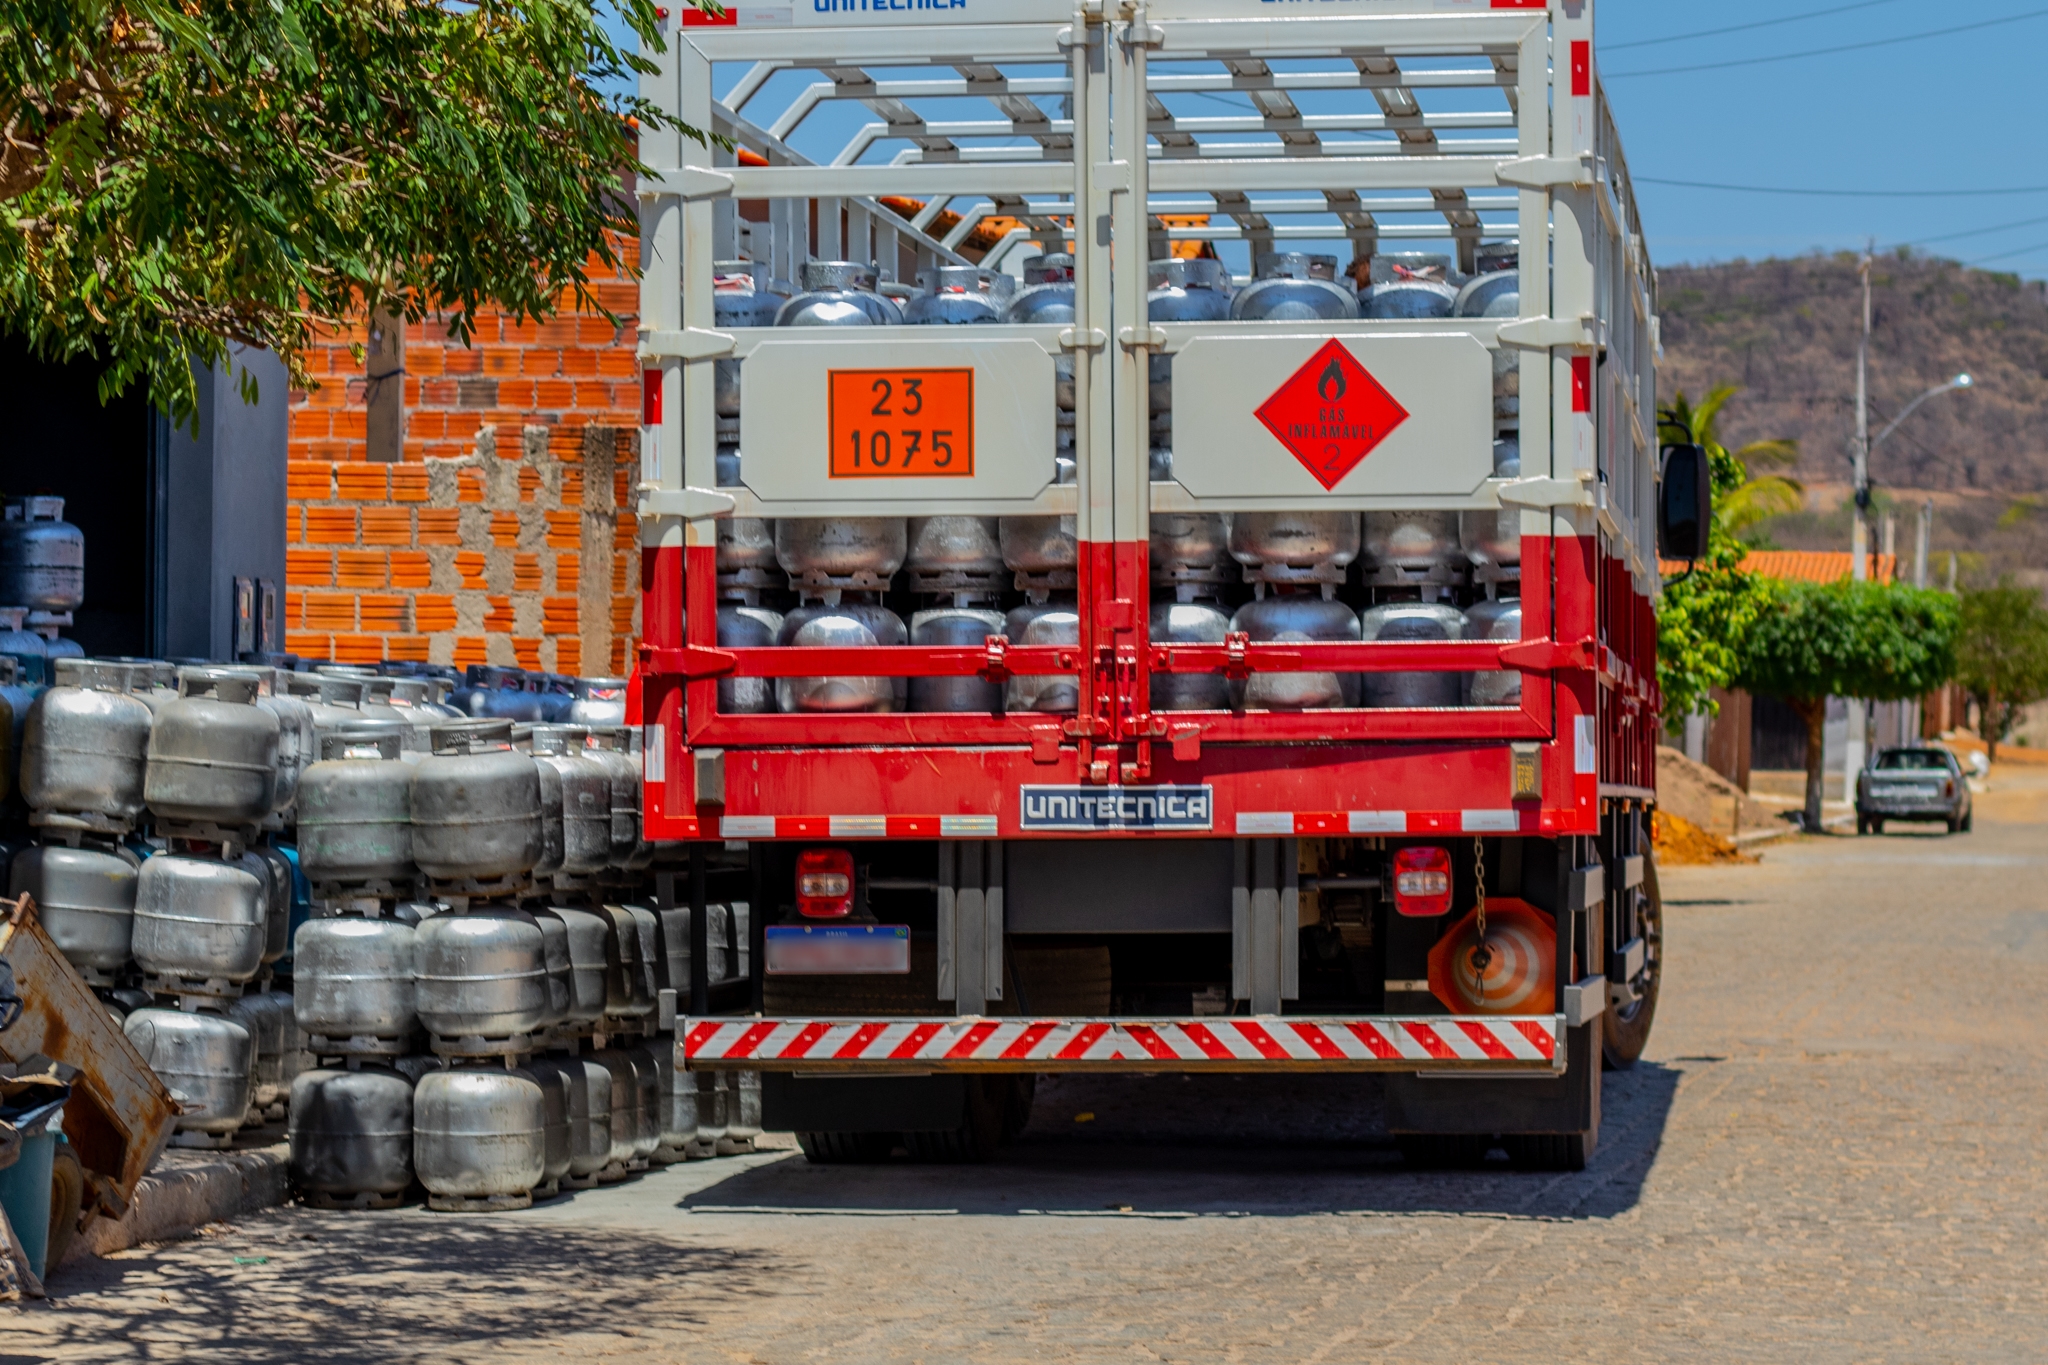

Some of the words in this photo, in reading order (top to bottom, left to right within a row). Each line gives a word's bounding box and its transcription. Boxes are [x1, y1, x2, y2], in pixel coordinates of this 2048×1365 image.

[871, 378, 922, 416] 23
[1319, 406, 1345, 422] GÁS
[1288, 423, 1374, 439] INFLAMÁVEL
[851, 430, 952, 467] 1075
[1324, 443, 1341, 470] 2
[1026, 796, 1207, 818] UNITECNICA
